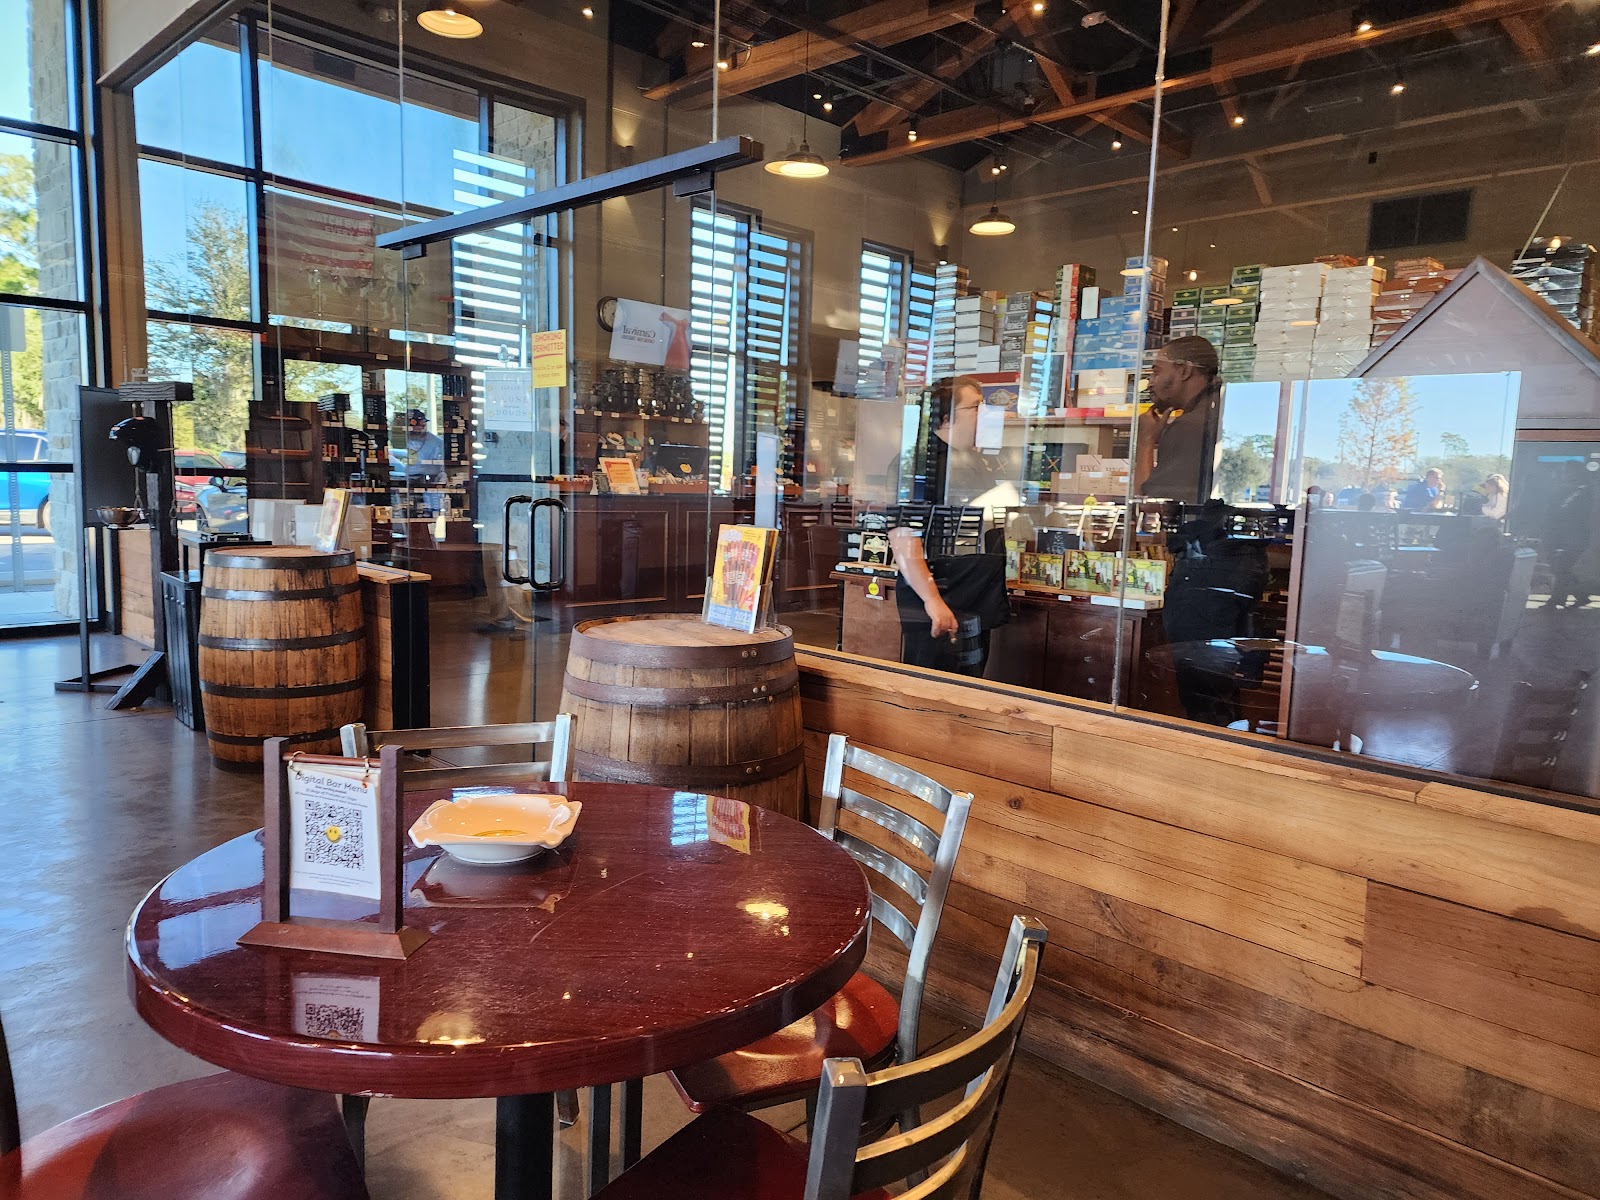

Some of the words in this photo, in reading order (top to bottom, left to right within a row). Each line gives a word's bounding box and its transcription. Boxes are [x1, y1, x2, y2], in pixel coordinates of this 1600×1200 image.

[535, 331, 562, 342] SMOKING
[533, 342, 564, 353] PERMITTED
[295, 773, 324, 785] Digital
[327, 778, 342, 789] Bar
[344, 782, 368, 795] Menu
